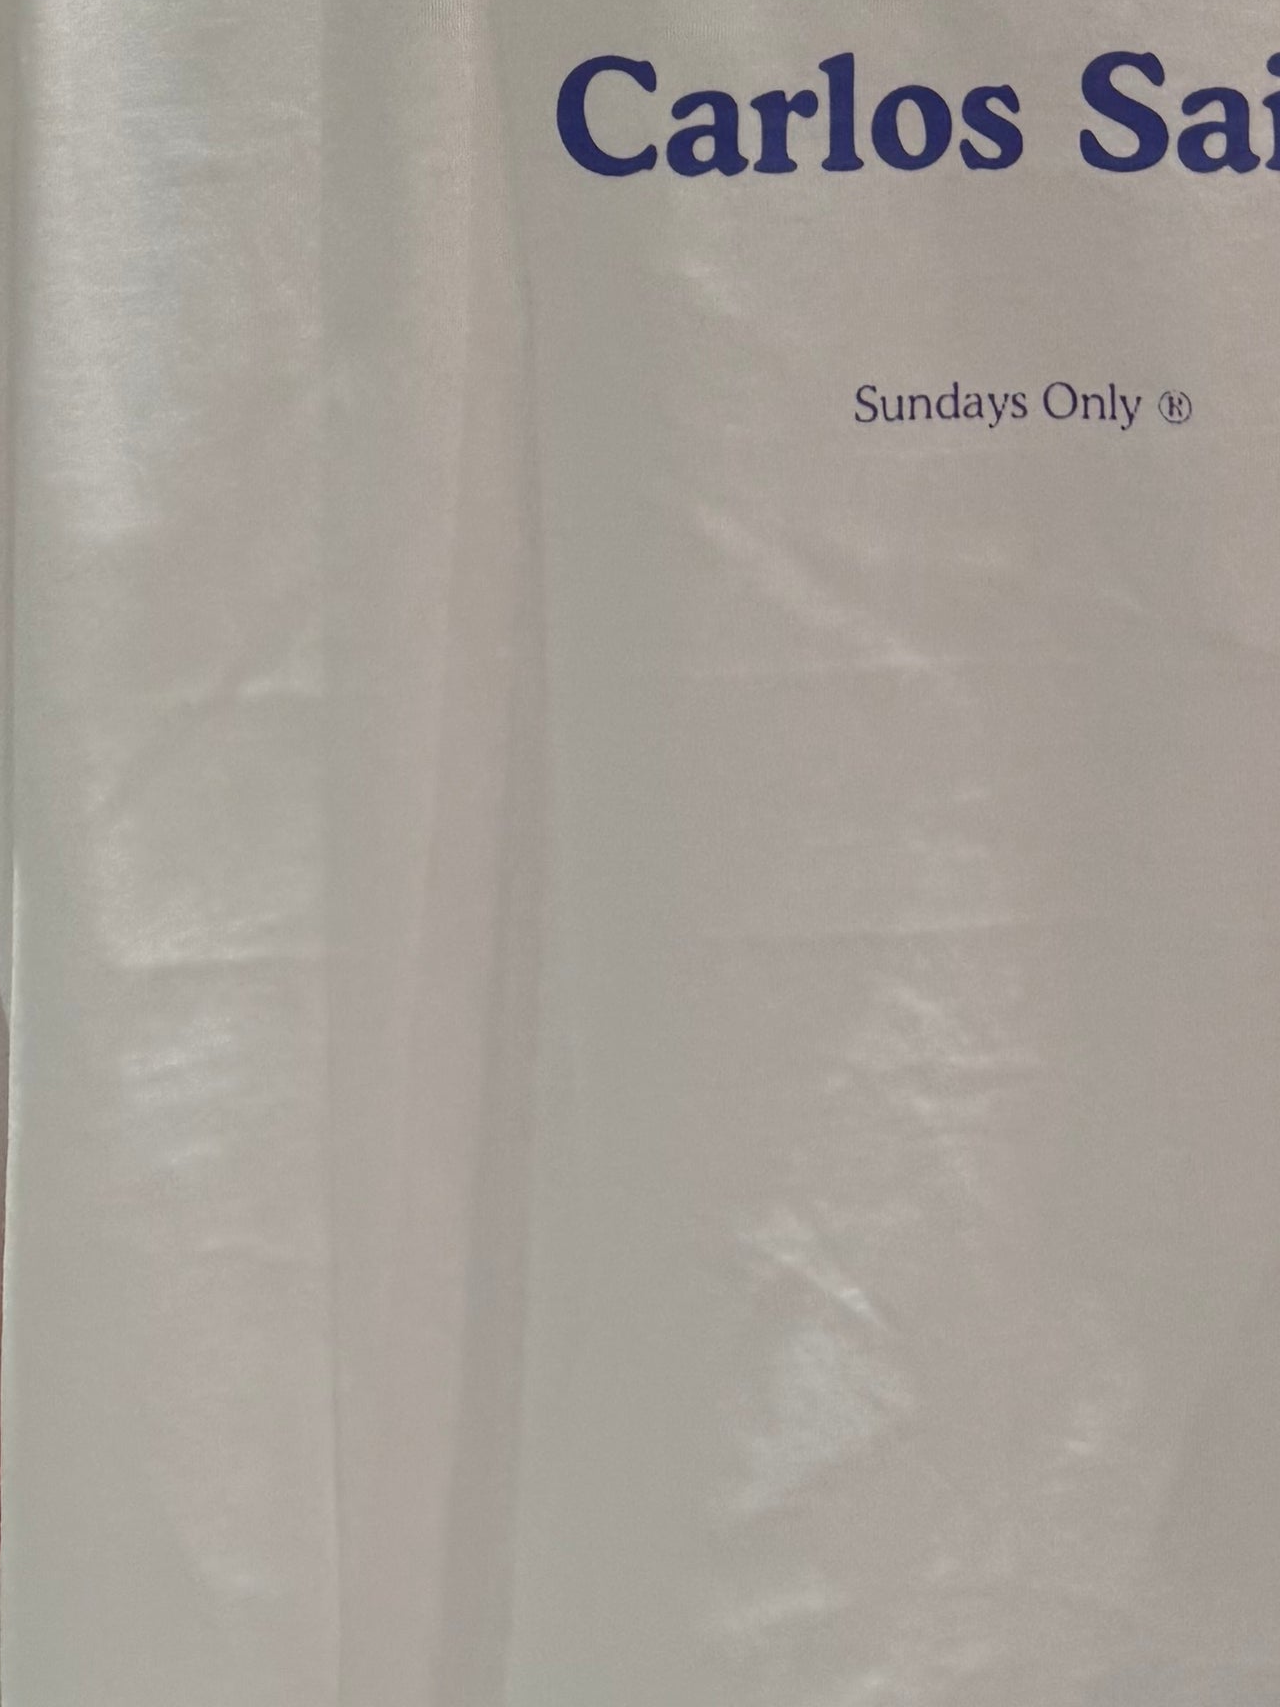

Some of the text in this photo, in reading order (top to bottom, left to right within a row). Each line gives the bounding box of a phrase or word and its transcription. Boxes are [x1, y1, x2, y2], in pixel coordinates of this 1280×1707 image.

[554, 52, 1024, 178] Carlos
[853, 381, 1029, 429] Sundays
[1042, 380, 1143, 432] Only
